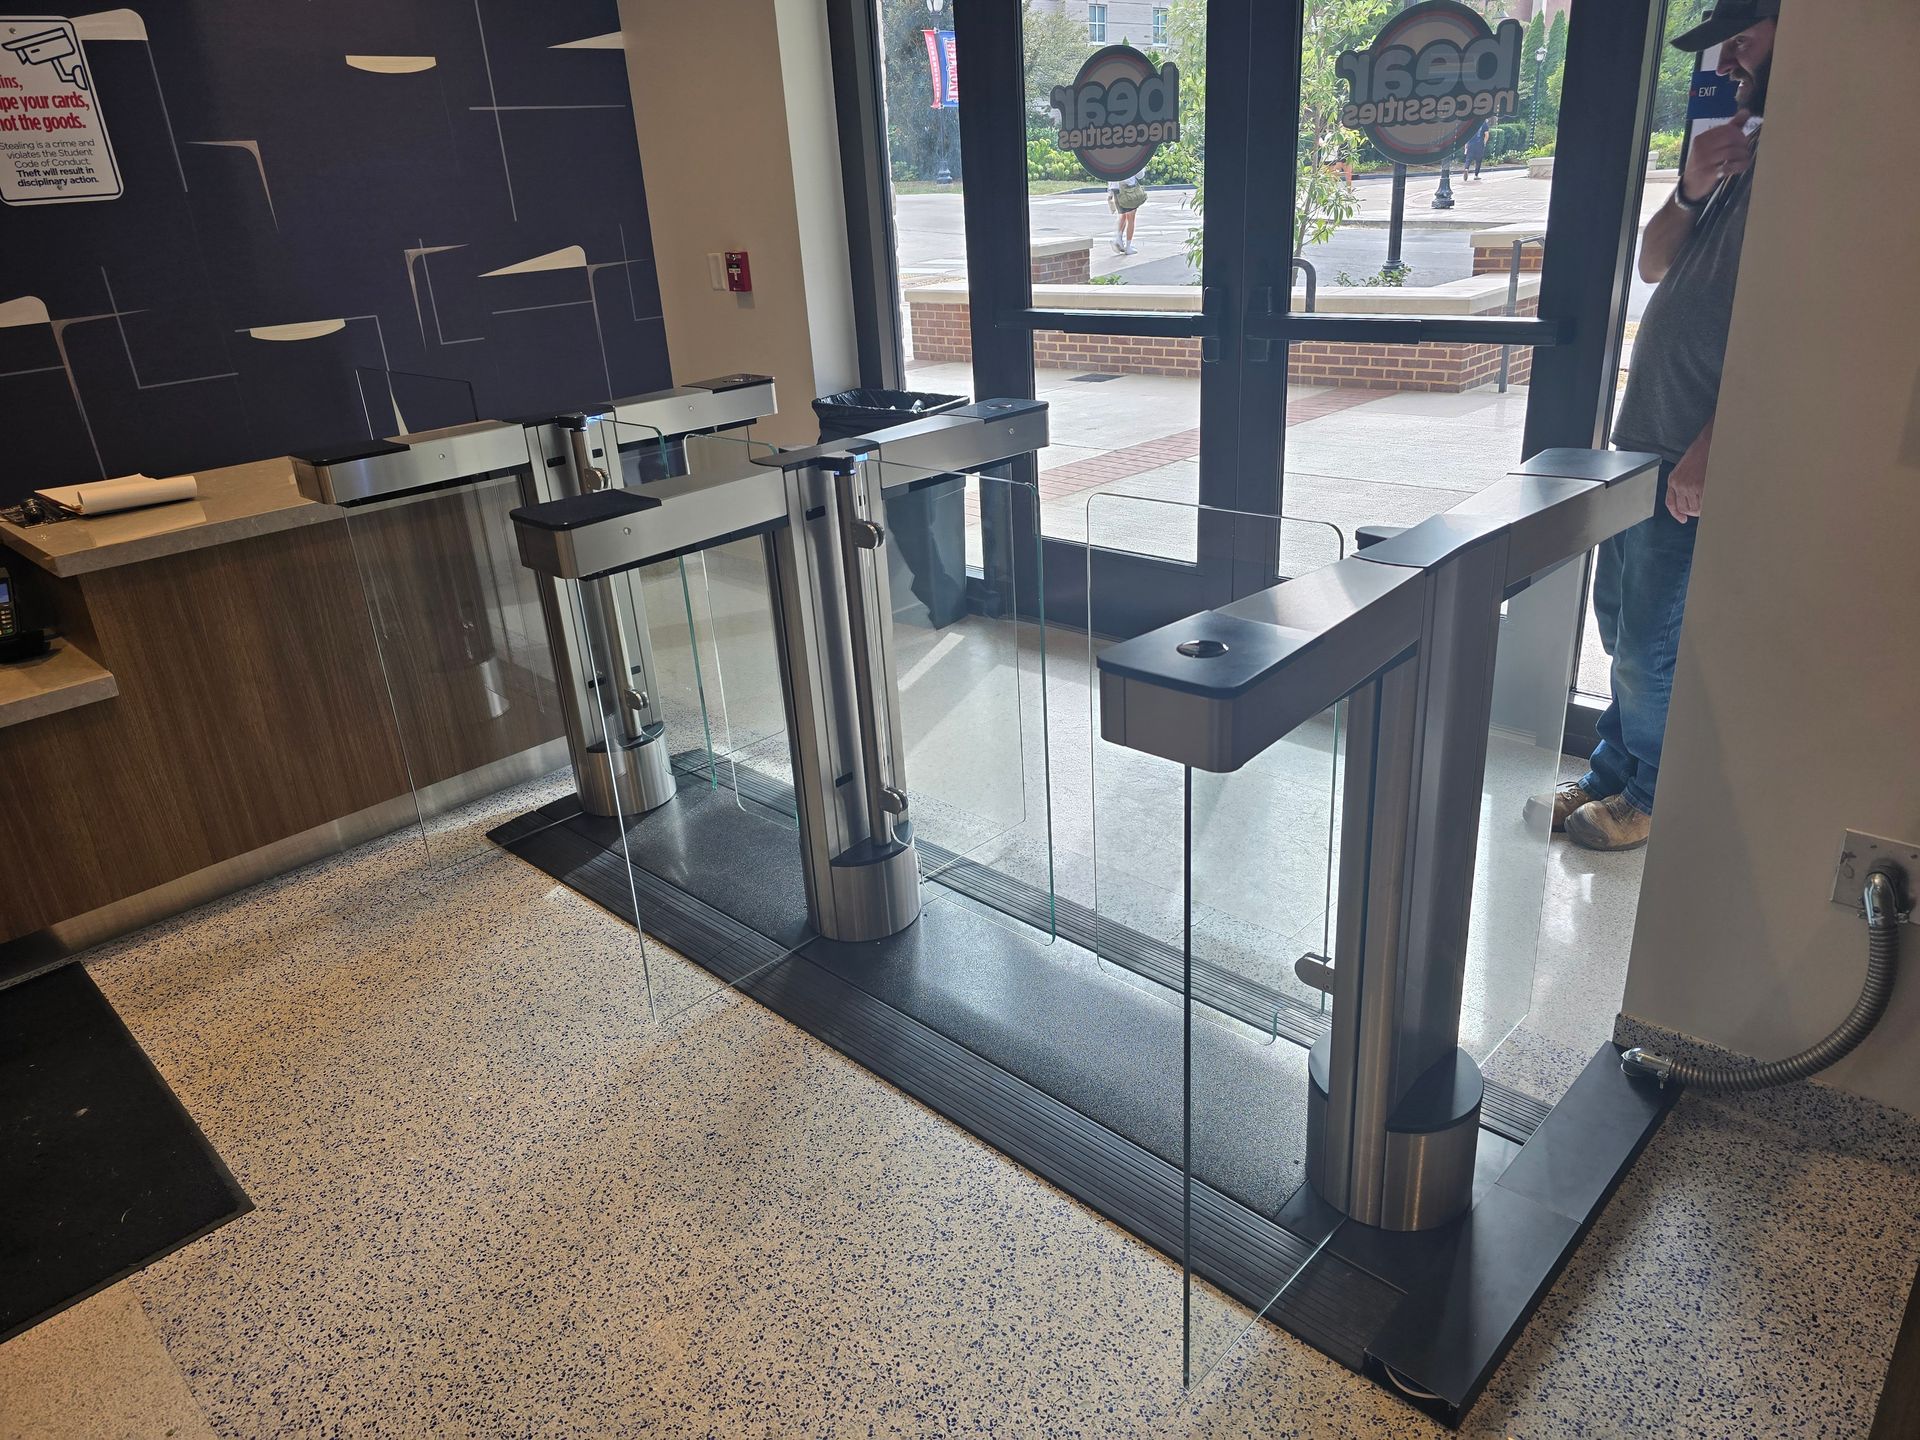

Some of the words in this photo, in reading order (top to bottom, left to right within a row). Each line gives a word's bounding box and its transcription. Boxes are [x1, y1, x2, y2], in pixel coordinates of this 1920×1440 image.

[0, 74, 23, 91] ins,
[1699, 86, 1717, 97] EXIT
[19, 95, 49, 112] your
[52, 91, 90, 111] cards,
[18, 114, 41, 130] the
[43, 112, 86, 132] goods.
[0, 141, 34, 150] Stealing
[37, 141, 43, 149] is
[7, 151, 41, 159] violates
[42, 150, 57, 158] the
[58, 148, 93, 157] Student
[15, 160, 39, 168] Code
[40, 159, 50, 167] of
[16, 169, 41, 177] Theft
[43, 168, 58, 176] will
[60, 167, 84, 175] result
[18, 178, 68, 187] disciplinary
[70, 176, 100, 185] action.
